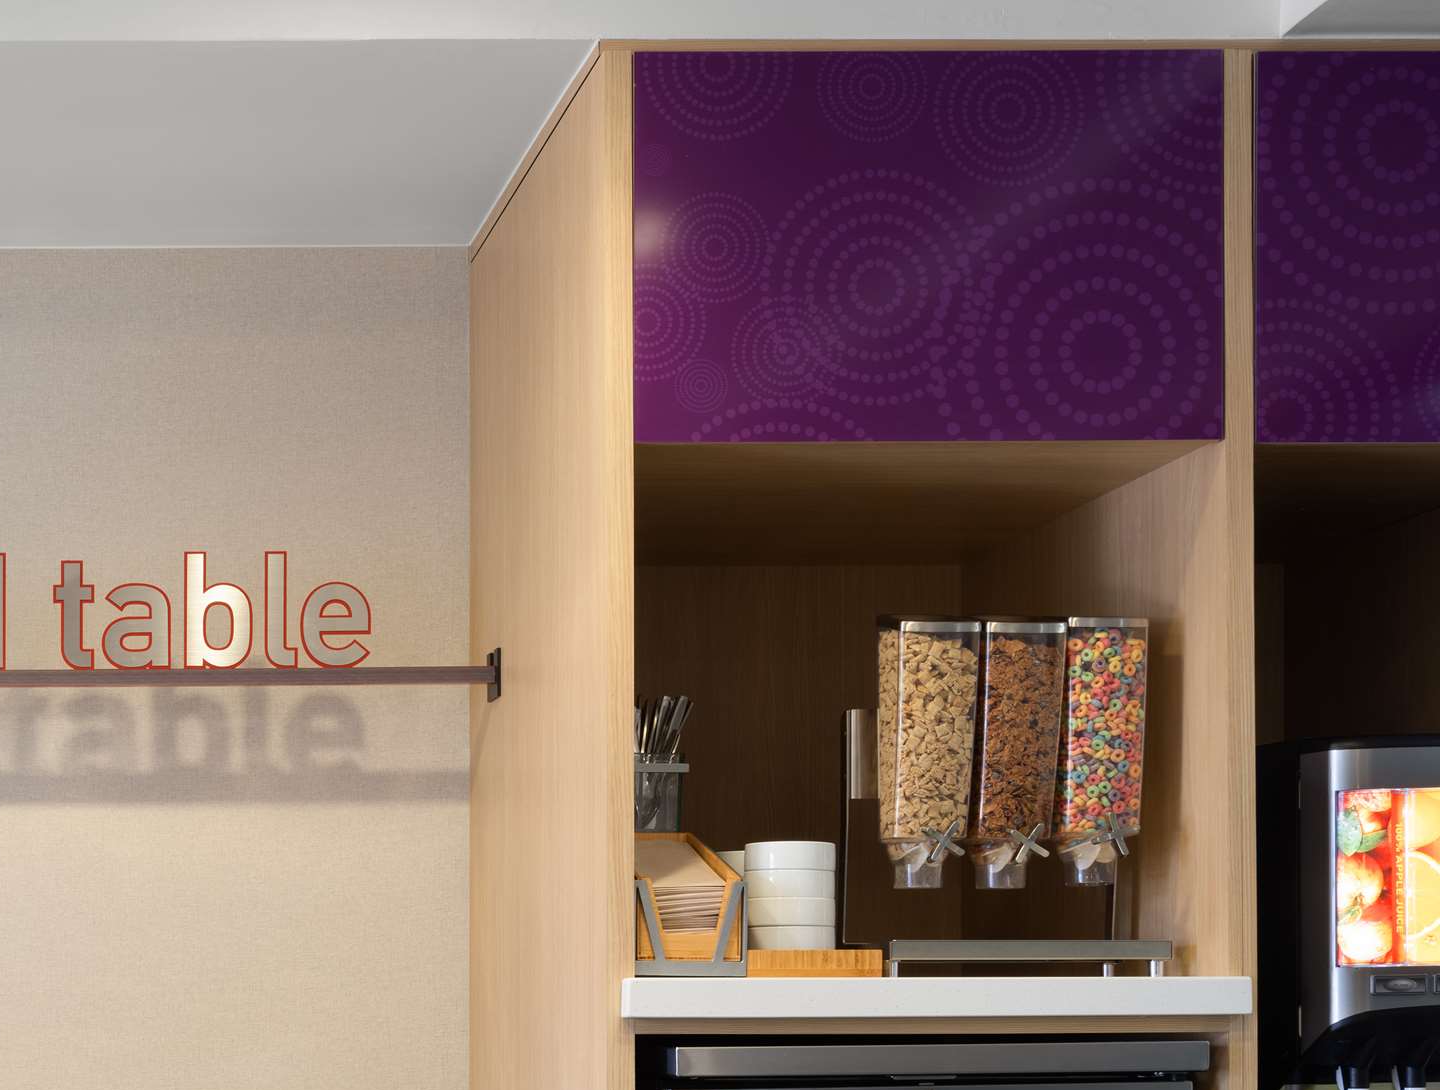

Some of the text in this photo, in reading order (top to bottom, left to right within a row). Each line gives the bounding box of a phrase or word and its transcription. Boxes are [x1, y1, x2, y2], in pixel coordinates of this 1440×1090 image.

[53, 551, 371, 670] table
[1395, 856, 1404, 897] APPLE
[1395, 899, 1404, 933] JUICE
